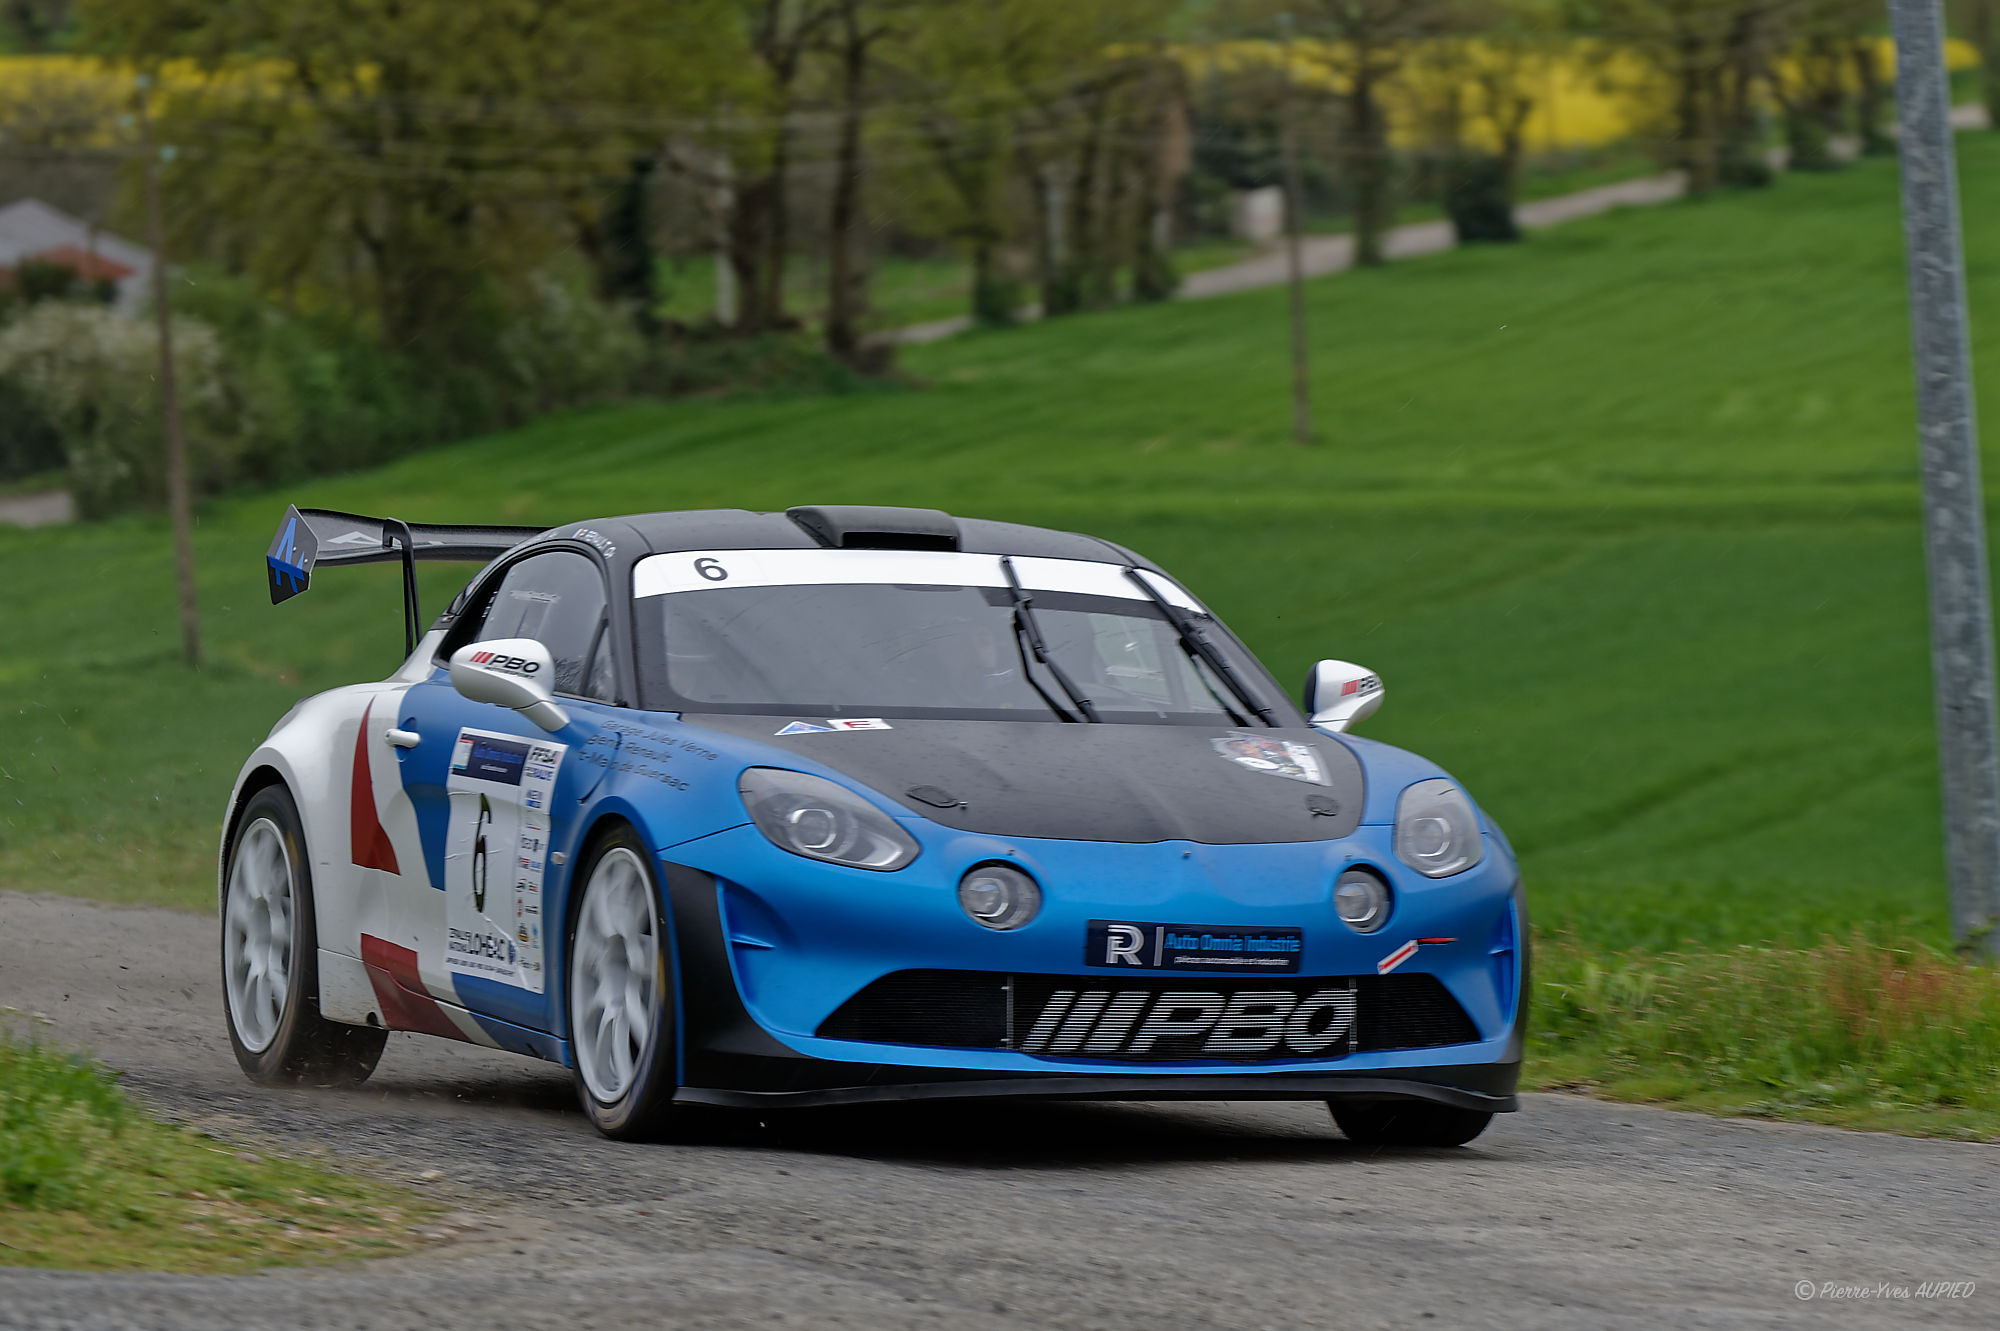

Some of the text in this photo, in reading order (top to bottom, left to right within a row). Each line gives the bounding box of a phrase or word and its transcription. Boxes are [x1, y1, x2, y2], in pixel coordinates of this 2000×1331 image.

[693, 557, 729, 582] 6
[488, 654, 540, 674] PBO
[473, 793, 492, 913] 6
[1163, 933, 1200, 950] Auto
[1200, 934, 1244, 951] Omnia
[1126, 989, 1357, 1053] PBO
